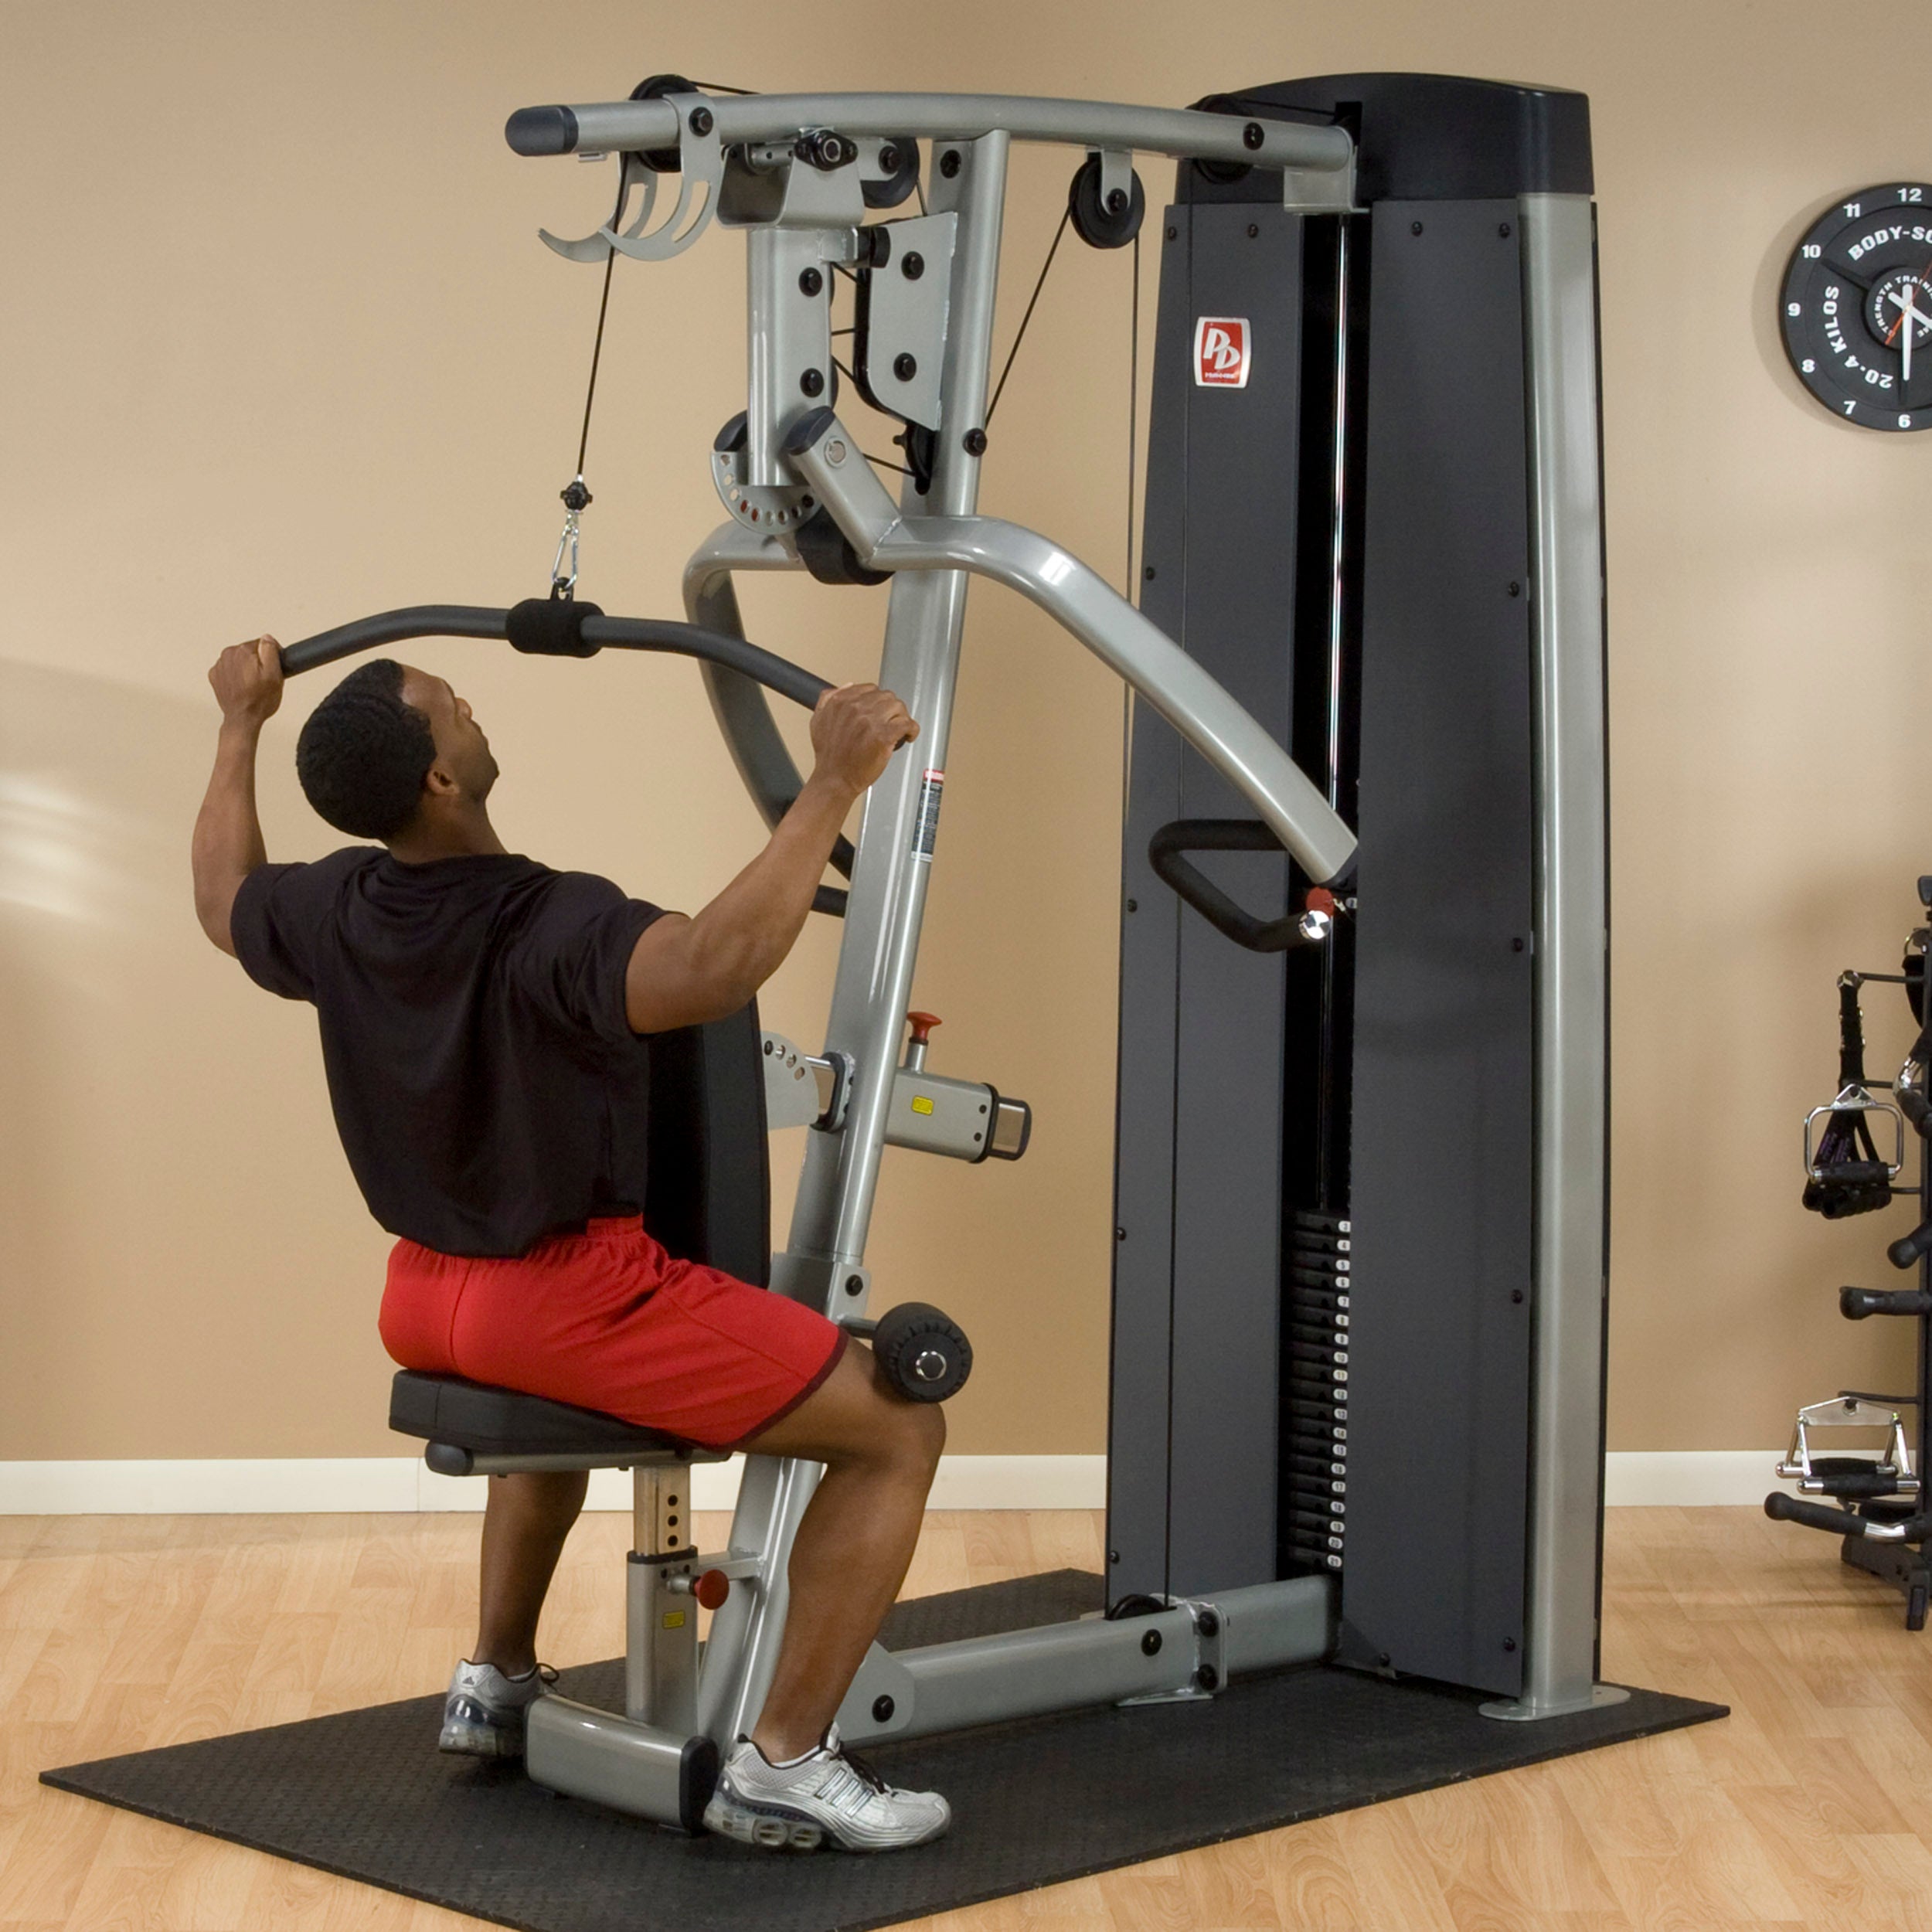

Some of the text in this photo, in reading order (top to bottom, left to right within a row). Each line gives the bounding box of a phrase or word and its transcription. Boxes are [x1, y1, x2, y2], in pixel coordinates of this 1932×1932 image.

[1897, 188, 1922, 202] 12
[1843, 203, 1860, 217] 11
[1802, 244, 1821, 258] 10
[1787, 302, 1801, 317] 9
[1823, 286, 1847, 354] KILOS
[1801, 359, 1815, 372] 8
[1844, 400, 1856, 414] 7
[1898, 414, 1911, 428] 6
